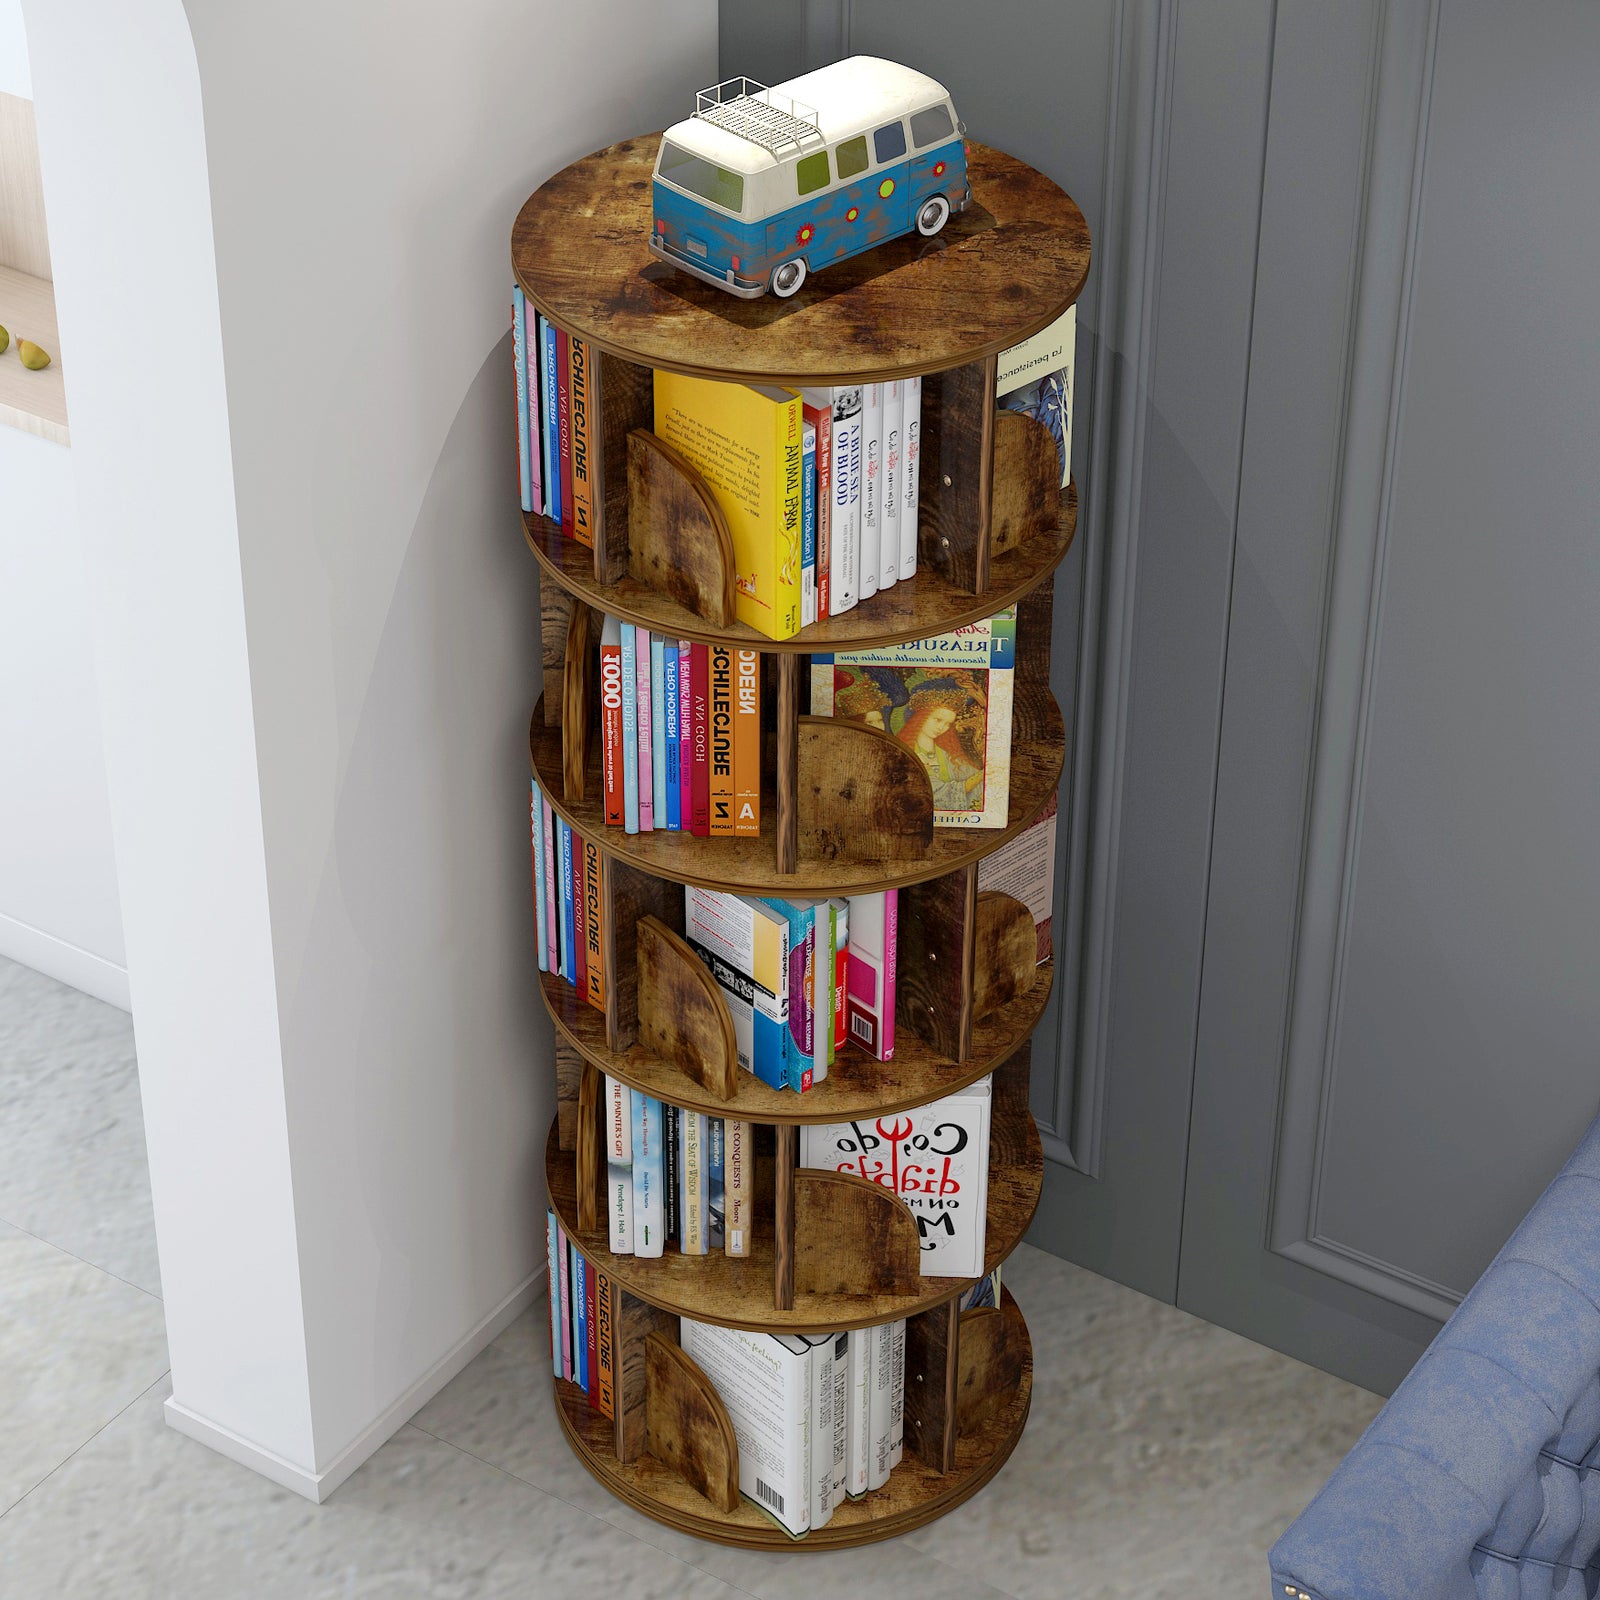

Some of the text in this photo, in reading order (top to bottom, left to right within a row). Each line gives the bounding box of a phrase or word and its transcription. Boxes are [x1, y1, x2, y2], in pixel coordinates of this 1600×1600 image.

[788, 404, 797, 441] ORWELL
[837, 431, 849, 506] OF BLOOD
[850, 425, 859, 505] A BLUE SEA
[785, 443, 800, 531] ANIMAL FARM
[821, 473, 829, 487] See
[835, 985, 843, 1013] Design
[615, 1140, 623, 1158] GIFT
[688, 1129, 696, 1141] THE
[687, 1142, 698, 1158] SEAT
[688, 1159, 696, 1168] OF
[688, 1168, 698, 1195] WISDOM
[732, 1133, 741, 1223] CONQUESTS Moore
[617, 1184, 625, 1212] Penelope
